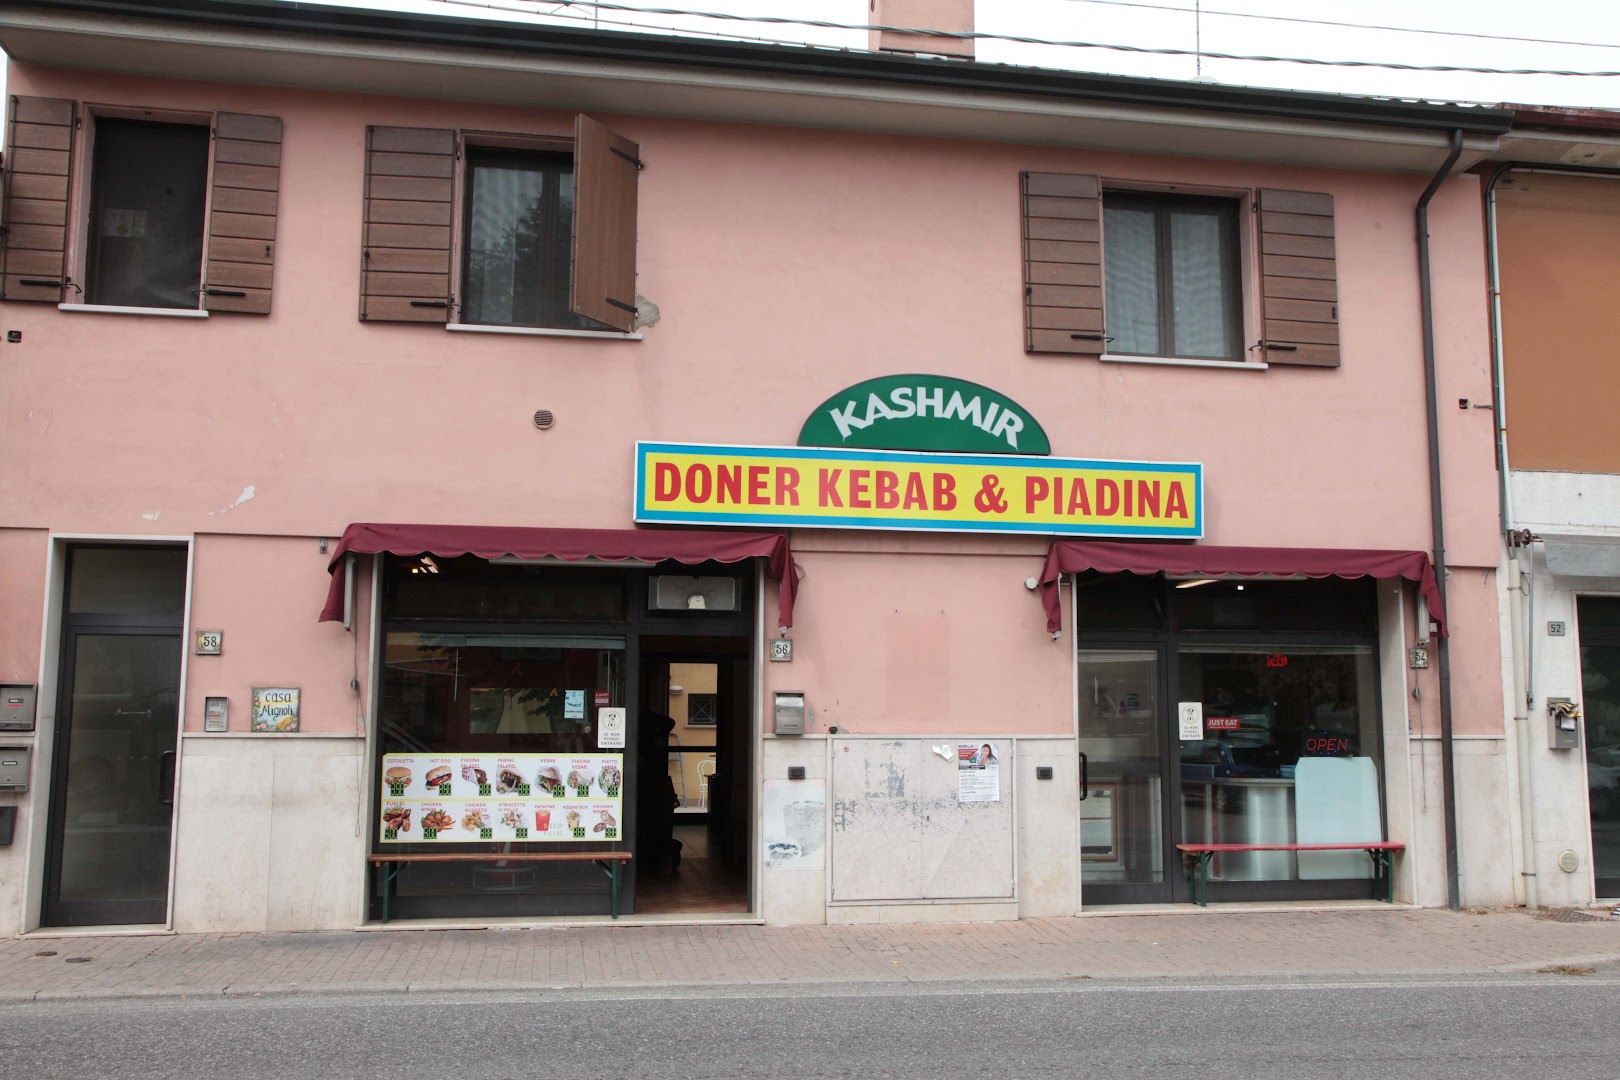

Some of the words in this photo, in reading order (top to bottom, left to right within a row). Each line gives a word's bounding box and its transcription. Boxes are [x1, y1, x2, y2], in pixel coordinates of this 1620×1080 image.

[829, 387, 1025, 451] KASHMIR
[654, 462, 801, 507] DONER
[818, 468, 958, 512] KEBAB
[973, 473, 1009, 514] &
[1025, 475, 1190, 519] PIADINA
[1550, 624, 1561, 633] 52
[203, 635, 217, 647] 58
[776, 644, 788, 655] 56
[1415, 651, 1426, 662] 54
[1306, 738, 1349, 751] OPEN
